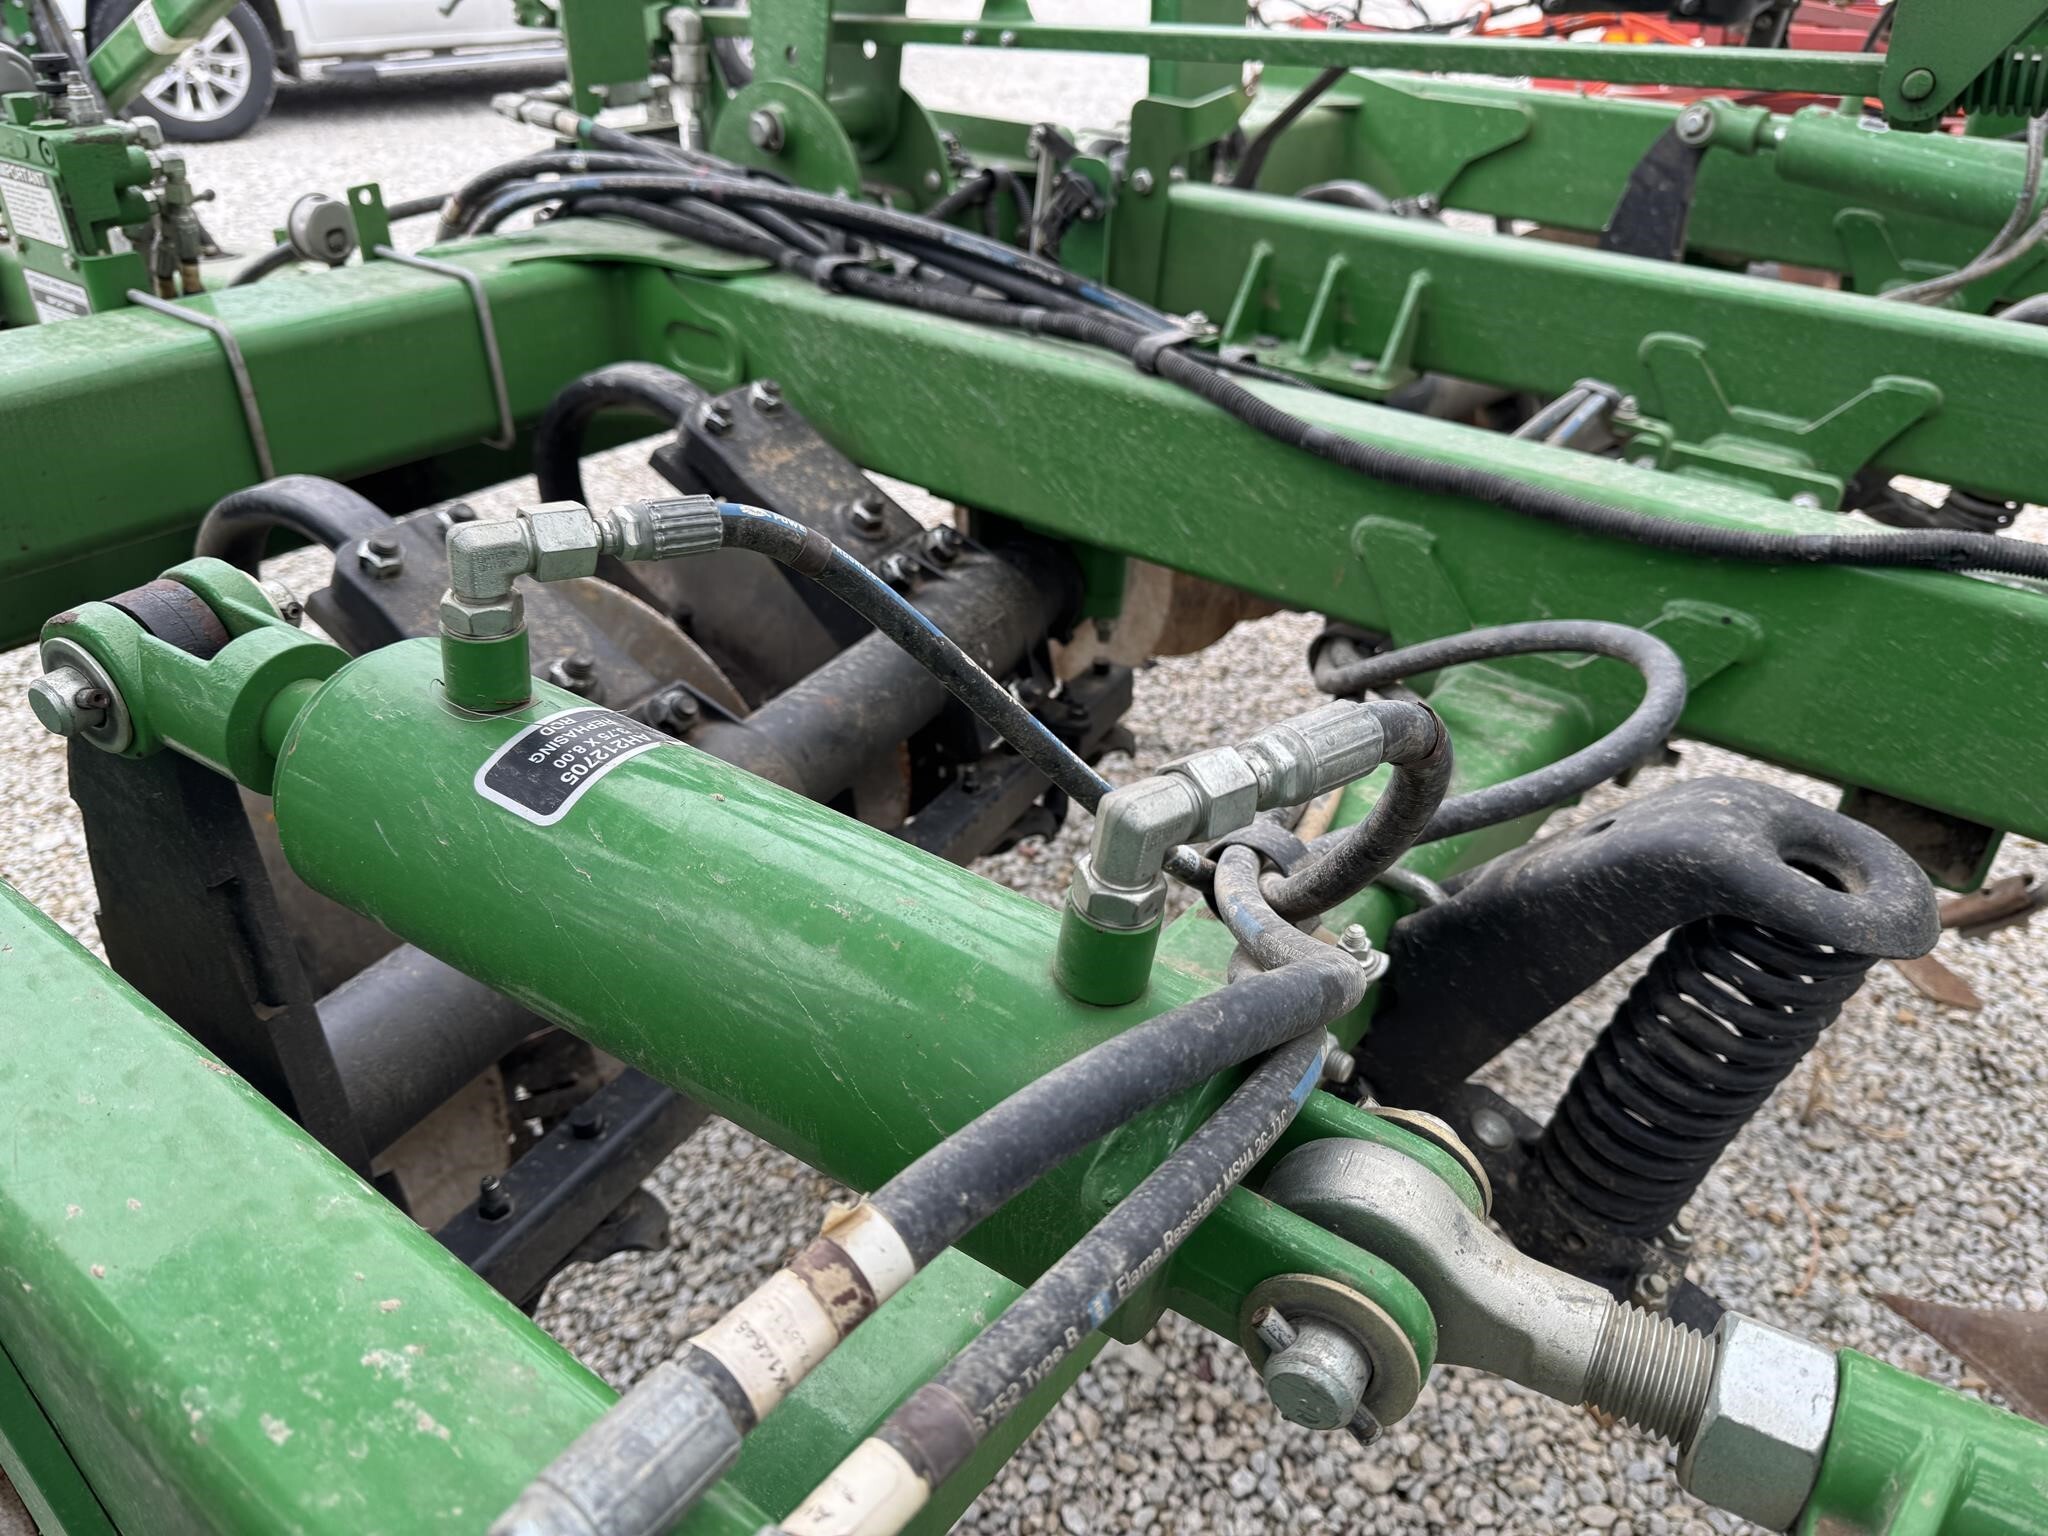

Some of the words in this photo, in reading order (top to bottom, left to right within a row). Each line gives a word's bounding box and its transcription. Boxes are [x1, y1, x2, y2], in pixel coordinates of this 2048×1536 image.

[540, 717, 577, 736] ROD
[598, 727, 632, 741] 3.75
[528, 716, 619, 764] REPHASING
[583, 737, 600, 747] X
[553, 745, 587, 768] 8.00
[561, 733, 652, 785] AH212705
[1020, 1345, 1065, 1390] Type
[1063, 1326, 1081, 1350] B
[1115, 1246, 1162, 1299] Flame
[1162, 1183, 1222, 1253] Resistant
[1222, 1147, 1255, 1191] MSHA
